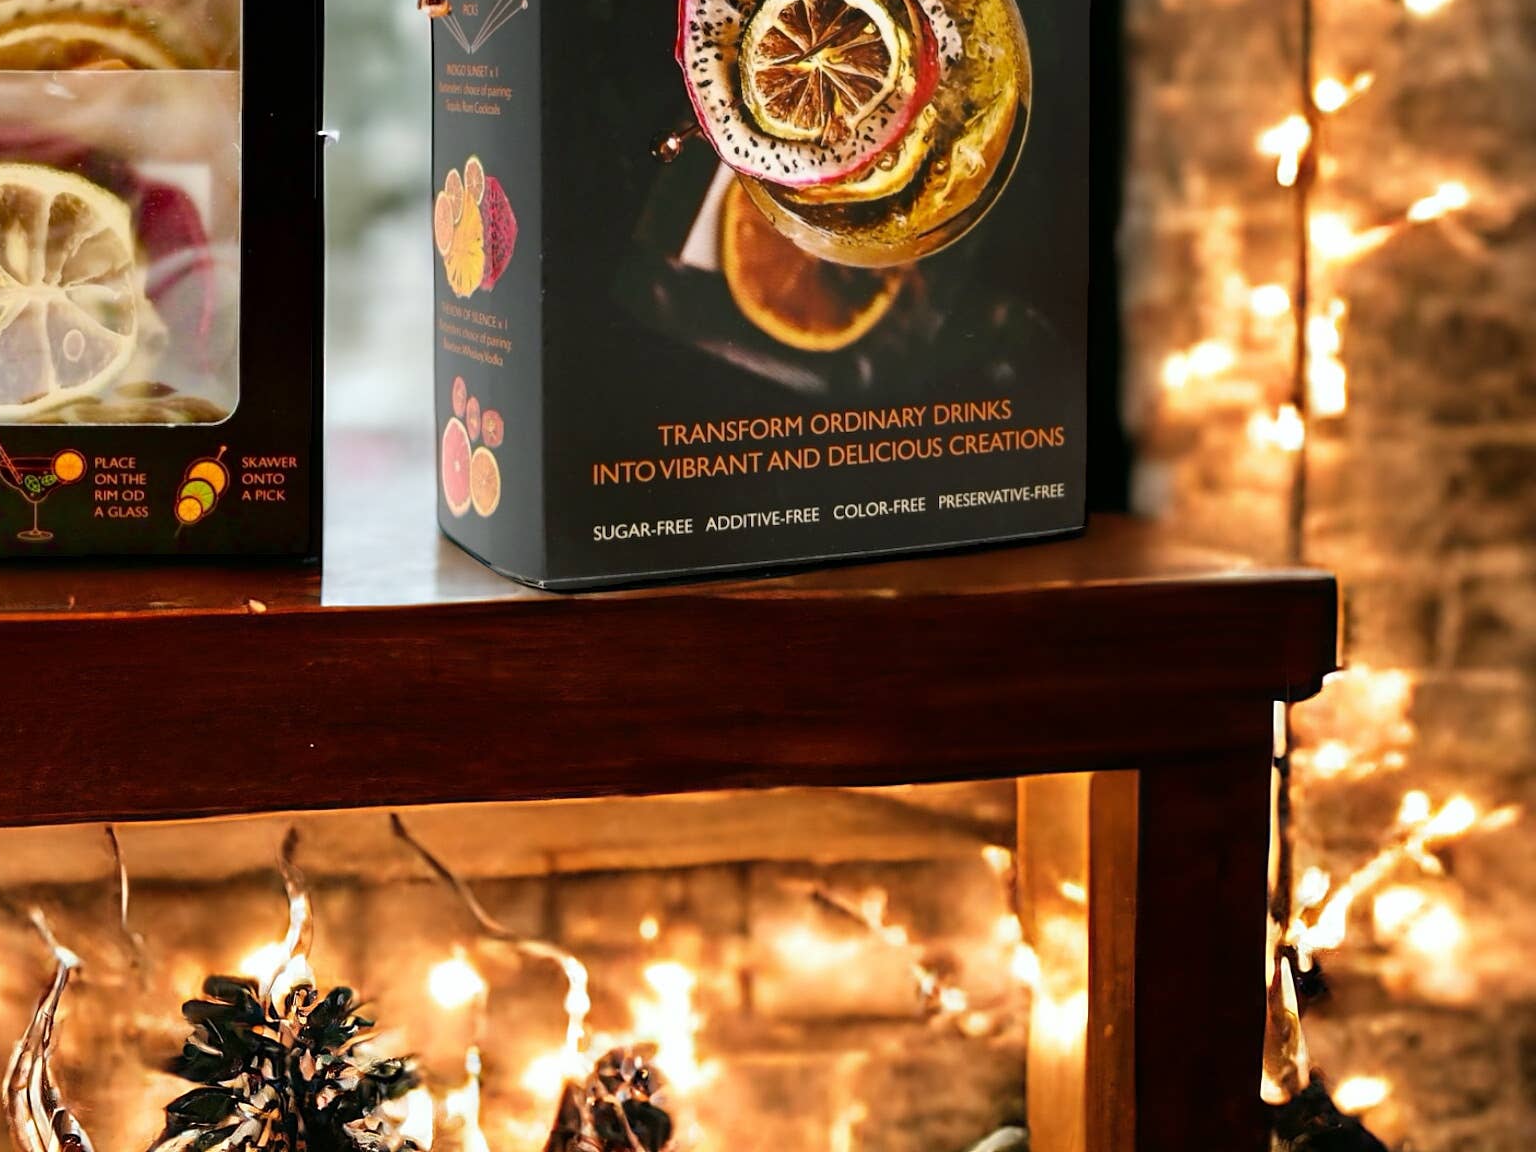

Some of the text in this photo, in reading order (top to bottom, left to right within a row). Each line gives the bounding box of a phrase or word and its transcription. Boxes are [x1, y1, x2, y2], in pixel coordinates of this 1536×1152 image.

[658, 399, 1012, 446] TRANSFORM ORDINARY DRINKS
[593, 426, 1064, 485] INTO VIBRANT AND DELICIOUS CREATIONS
[95, 457, 135, 469] PLACE
[242, 457, 297, 468] SKAWER
[95, 473, 146, 485] ON THE
[242, 473, 285, 484] ONTO
[95, 490, 144, 501] RIM OD
[242, 489, 285, 501] A PICK
[94, 506, 148, 517] A GLASS
[593, 483, 1064, 541] SUGAR-FREE ADDITIVE-FREE COLOR-FREE PRESERVATIVE-FREE
